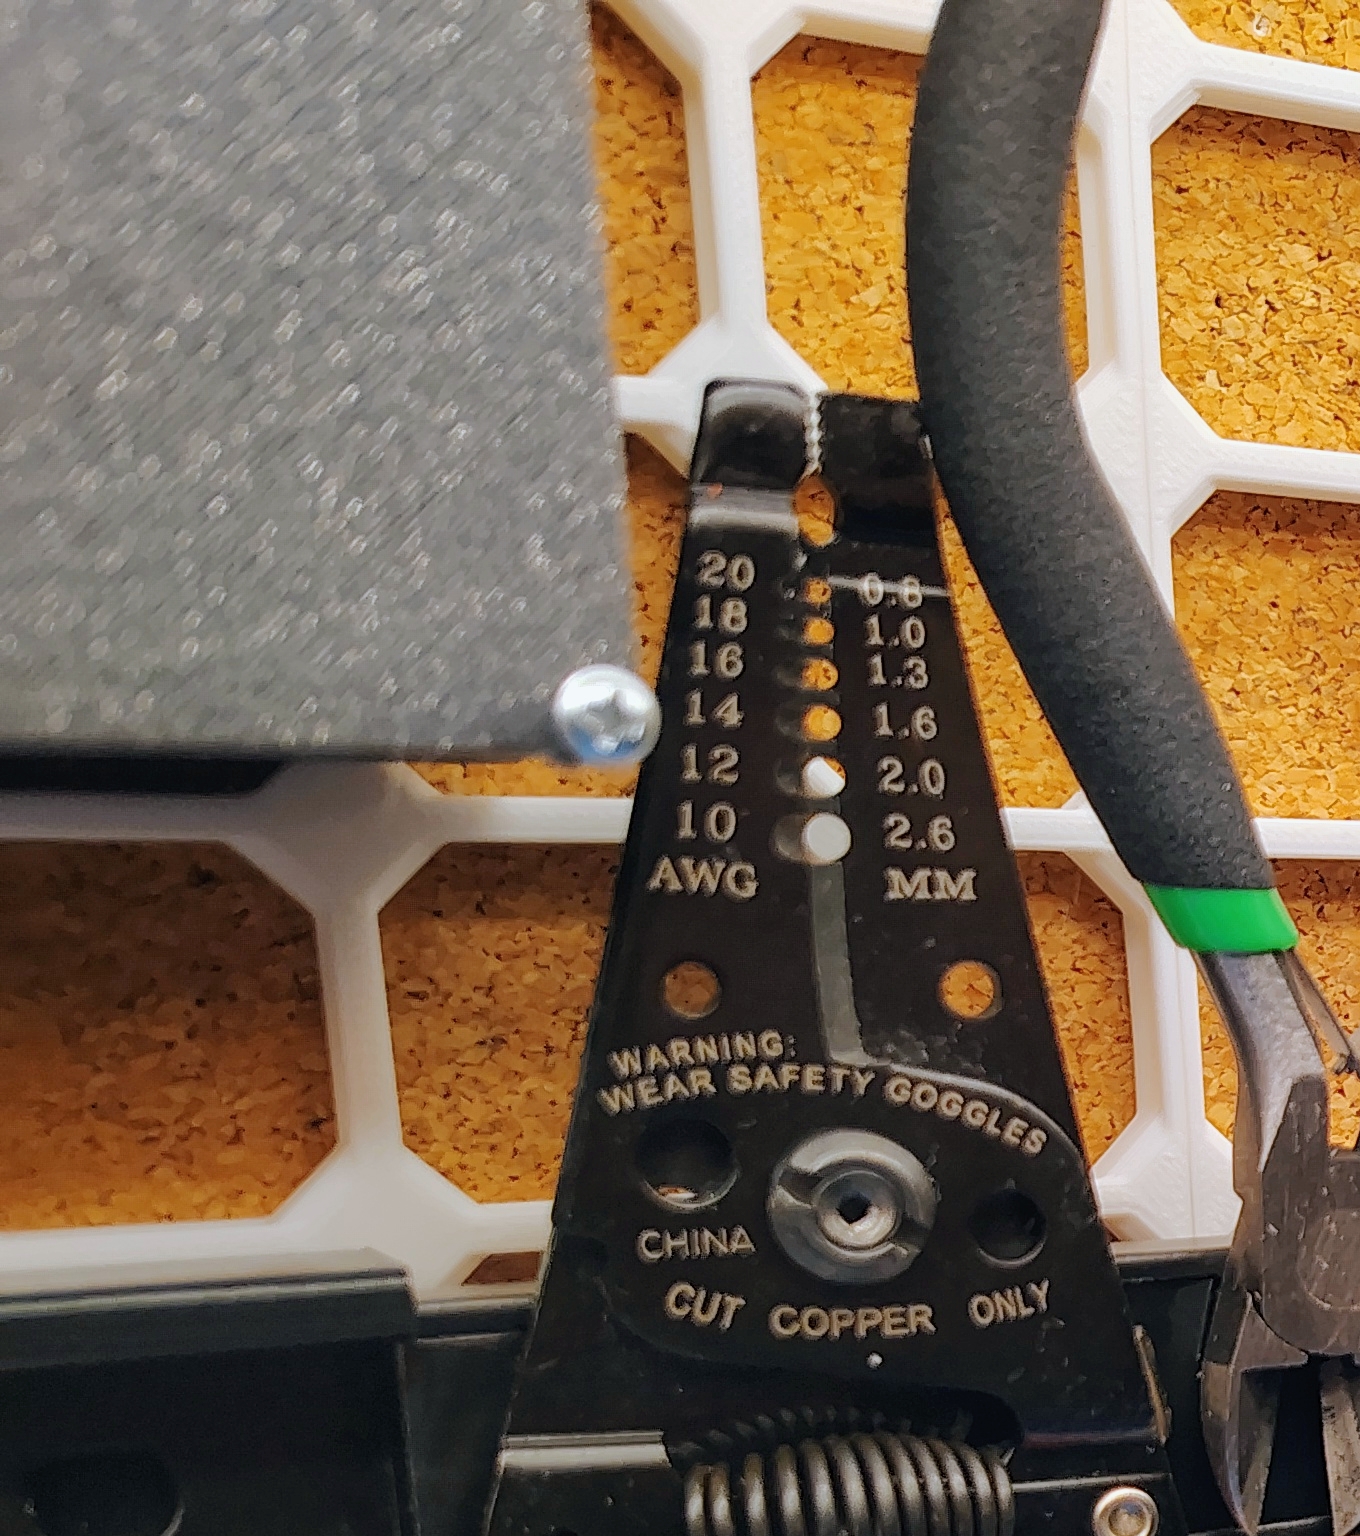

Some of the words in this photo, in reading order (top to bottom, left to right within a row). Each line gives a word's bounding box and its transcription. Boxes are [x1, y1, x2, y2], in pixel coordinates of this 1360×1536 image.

[699, 551, 755, 591] 20
[862, 573, 923, 609] 0.8
[697, 597, 747, 634] 18
[865, 615, 926, 650] 1.0
[692, 641, 743, 680] 16
[869, 655, 928, 690] 1.3
[686, 692, 743, 730] 14
[874, 704, 938, 740] 1.6
[681, 746, 740, 785] 12
[877, 757, 945, 796] 2.0
[677, 802, 737, 841] 10
[883, 815, 955, 852] 2.6
[648, 856, 758, 899] AWG
[885, 868, 978, 901] MM
[611, 1030, 797, 1078] WARNING:
[601, 1067, 717, 1115] WEAR
[728, 1064, 876, 1096] SAFETY
[883, 1076, 1048, 1156] GOGGLES
[637, 1226, 757, 1262] CHINA
[665, 1281, 745, 1329] CUT
[769, 1304, 937, 1341] COPPER
[967, 1281, 1052, 1328] ONLY
